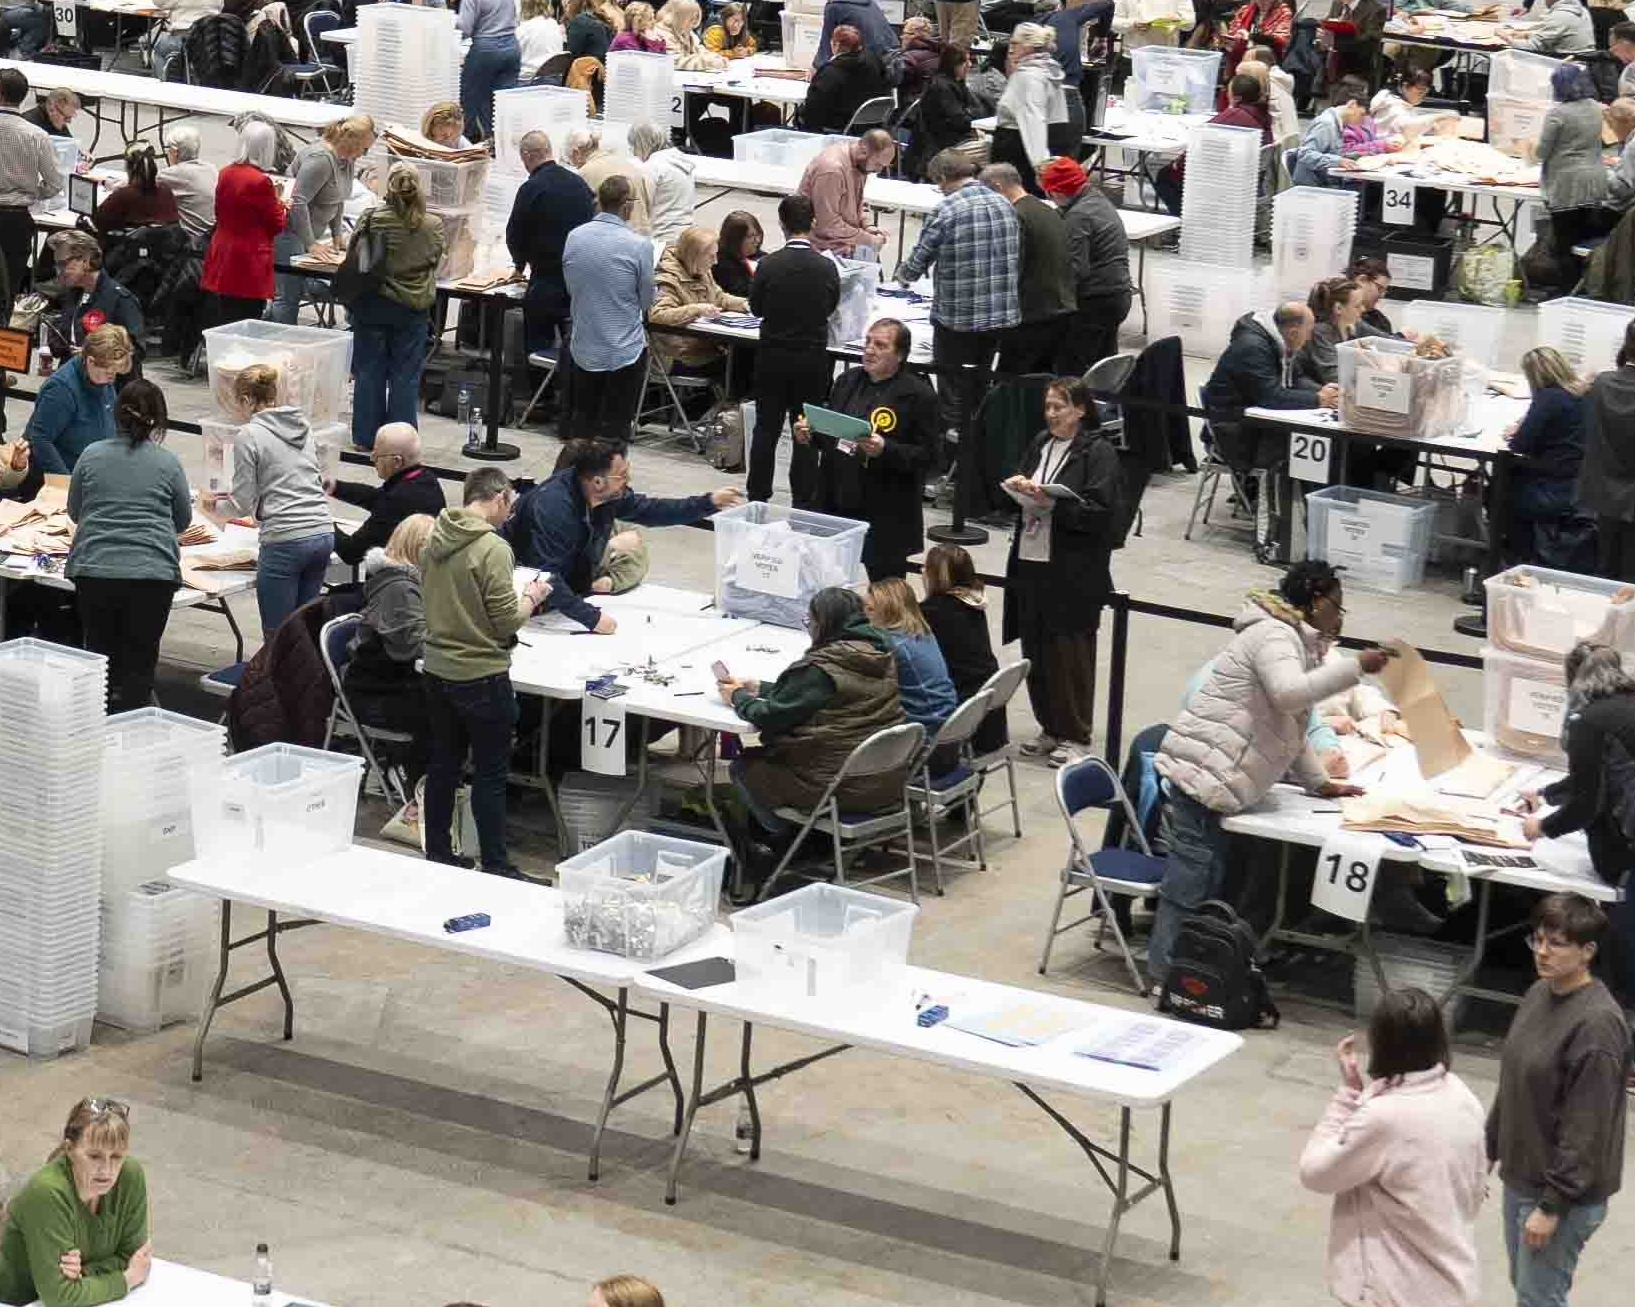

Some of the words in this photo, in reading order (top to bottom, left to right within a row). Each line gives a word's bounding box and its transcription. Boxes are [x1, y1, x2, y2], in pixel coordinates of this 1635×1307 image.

[55, 7, 74, 23] 30
[1385, 189, 1411, 209] 34
[1292, 436, 1326, 463] 20
[585, 716, 621, 749] 17
[1325, 853, 1370, 894] 18
